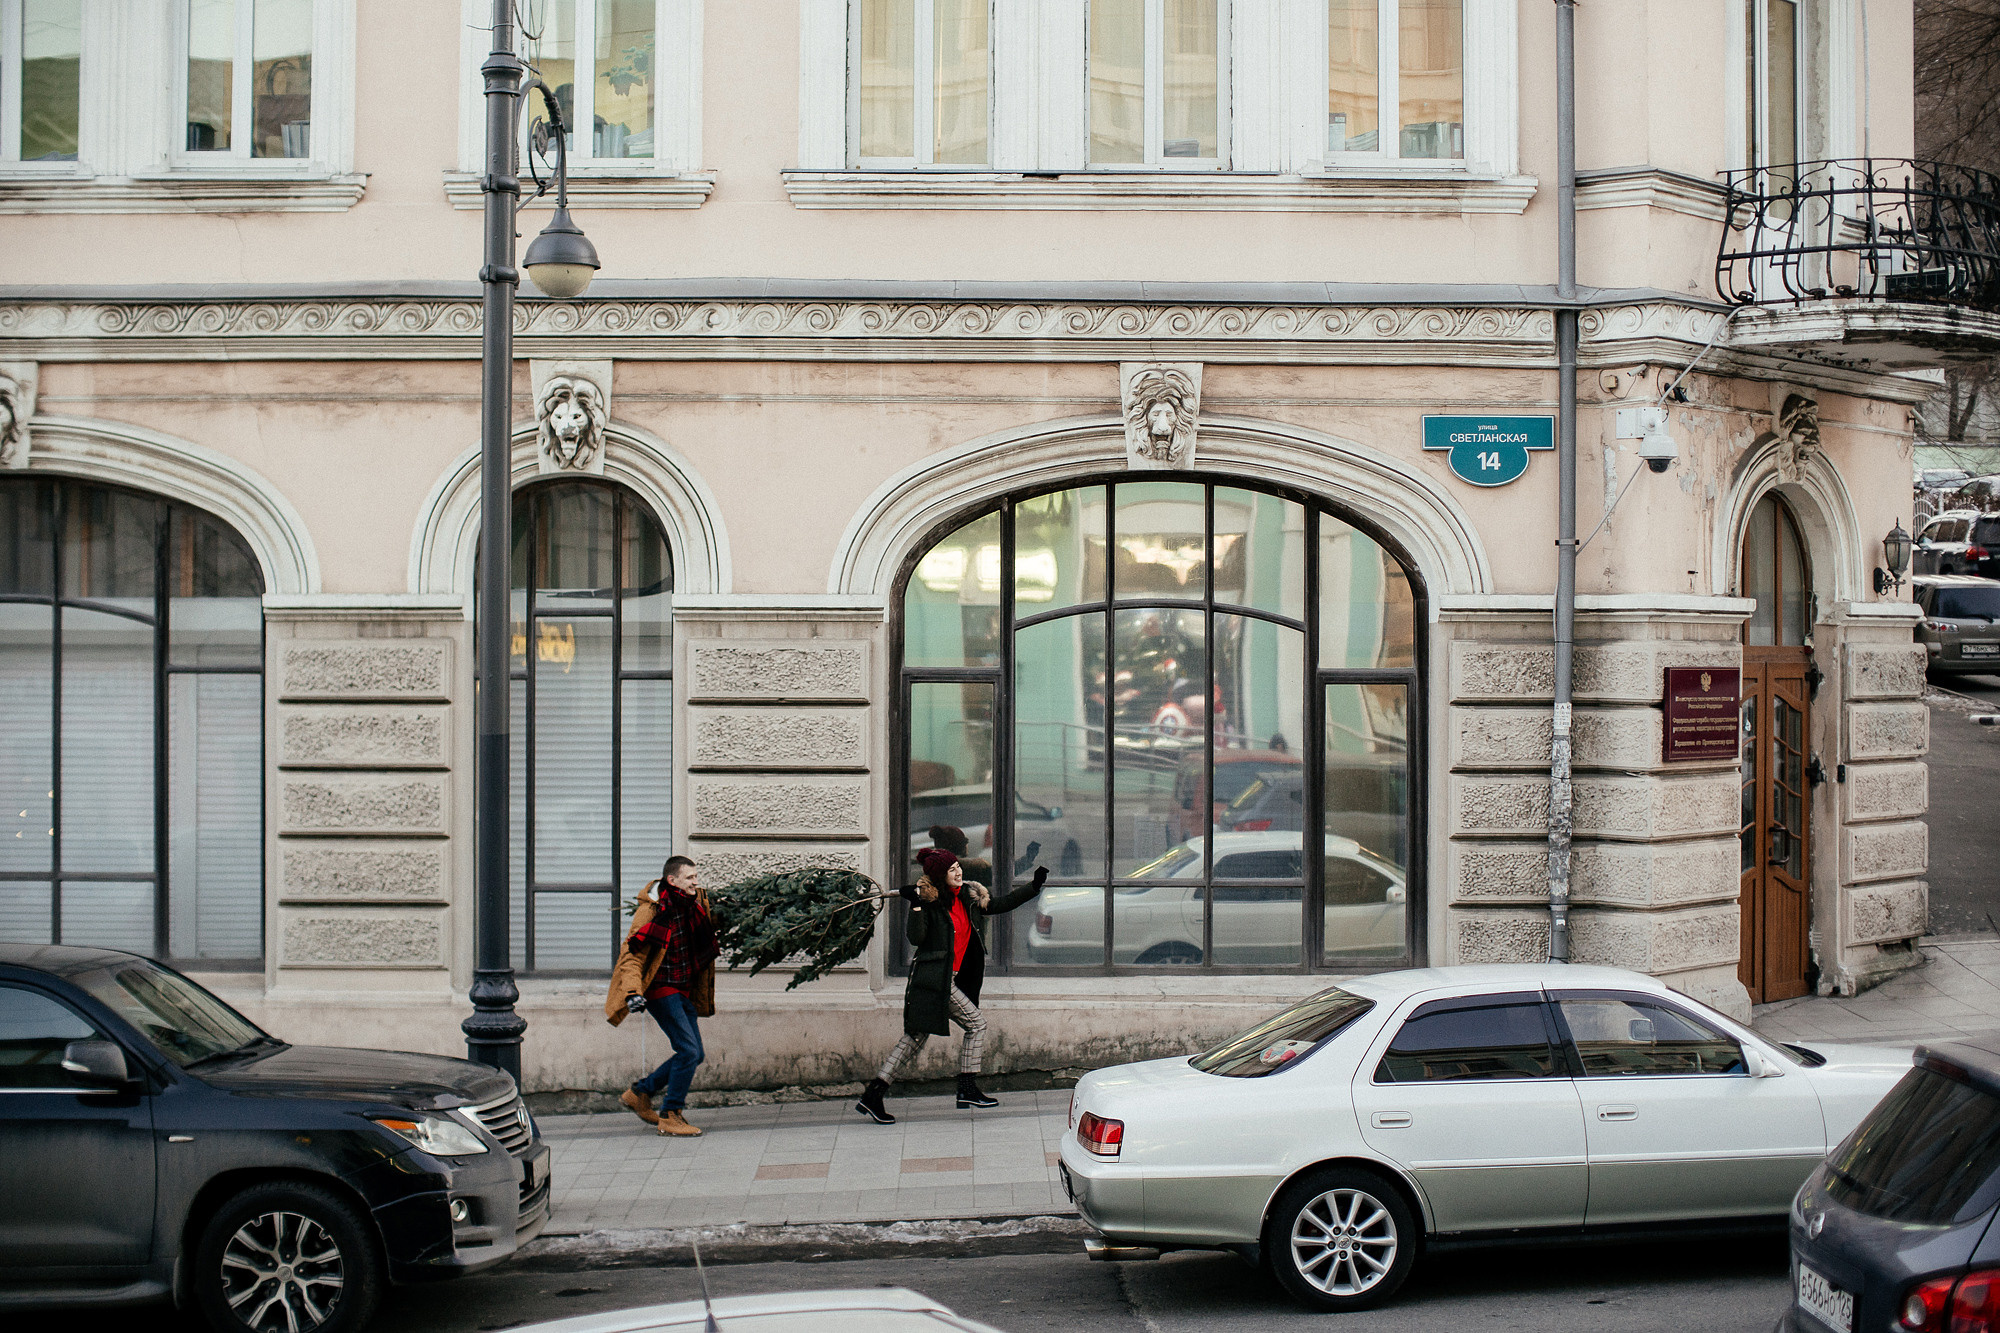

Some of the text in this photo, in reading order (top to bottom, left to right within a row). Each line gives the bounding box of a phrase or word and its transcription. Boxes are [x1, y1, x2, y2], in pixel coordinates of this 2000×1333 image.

[1450, 433, 1528, 443] СВЕТЛАНСКАЯ
[1476, 451, 1501, 471] 14
[1836, 1289, 1851, 1319] 125
